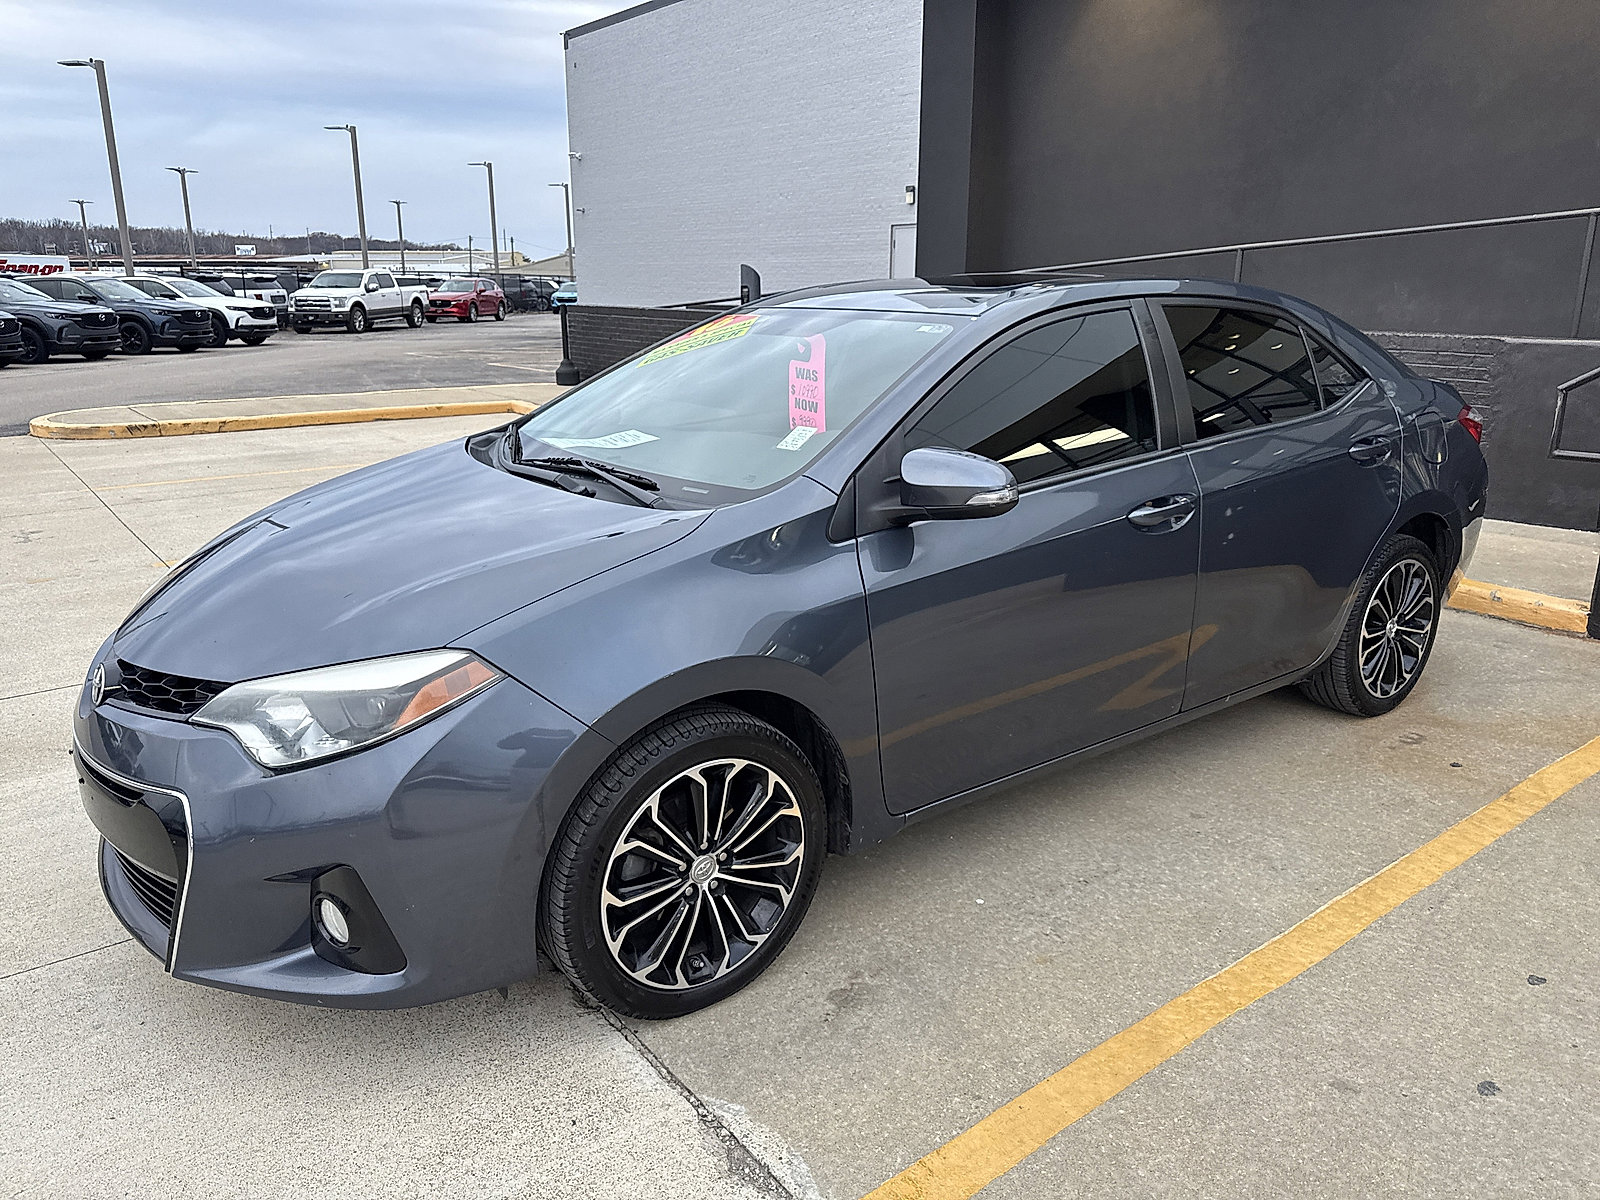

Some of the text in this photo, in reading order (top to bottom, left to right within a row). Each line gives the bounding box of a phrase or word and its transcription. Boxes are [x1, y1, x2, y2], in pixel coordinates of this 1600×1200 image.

[795, 366, 818, 382] WAS
[791, 384, 796, 395] $
[794, 397, 818, 413] NOW
[791, 417, 797, 428] $
